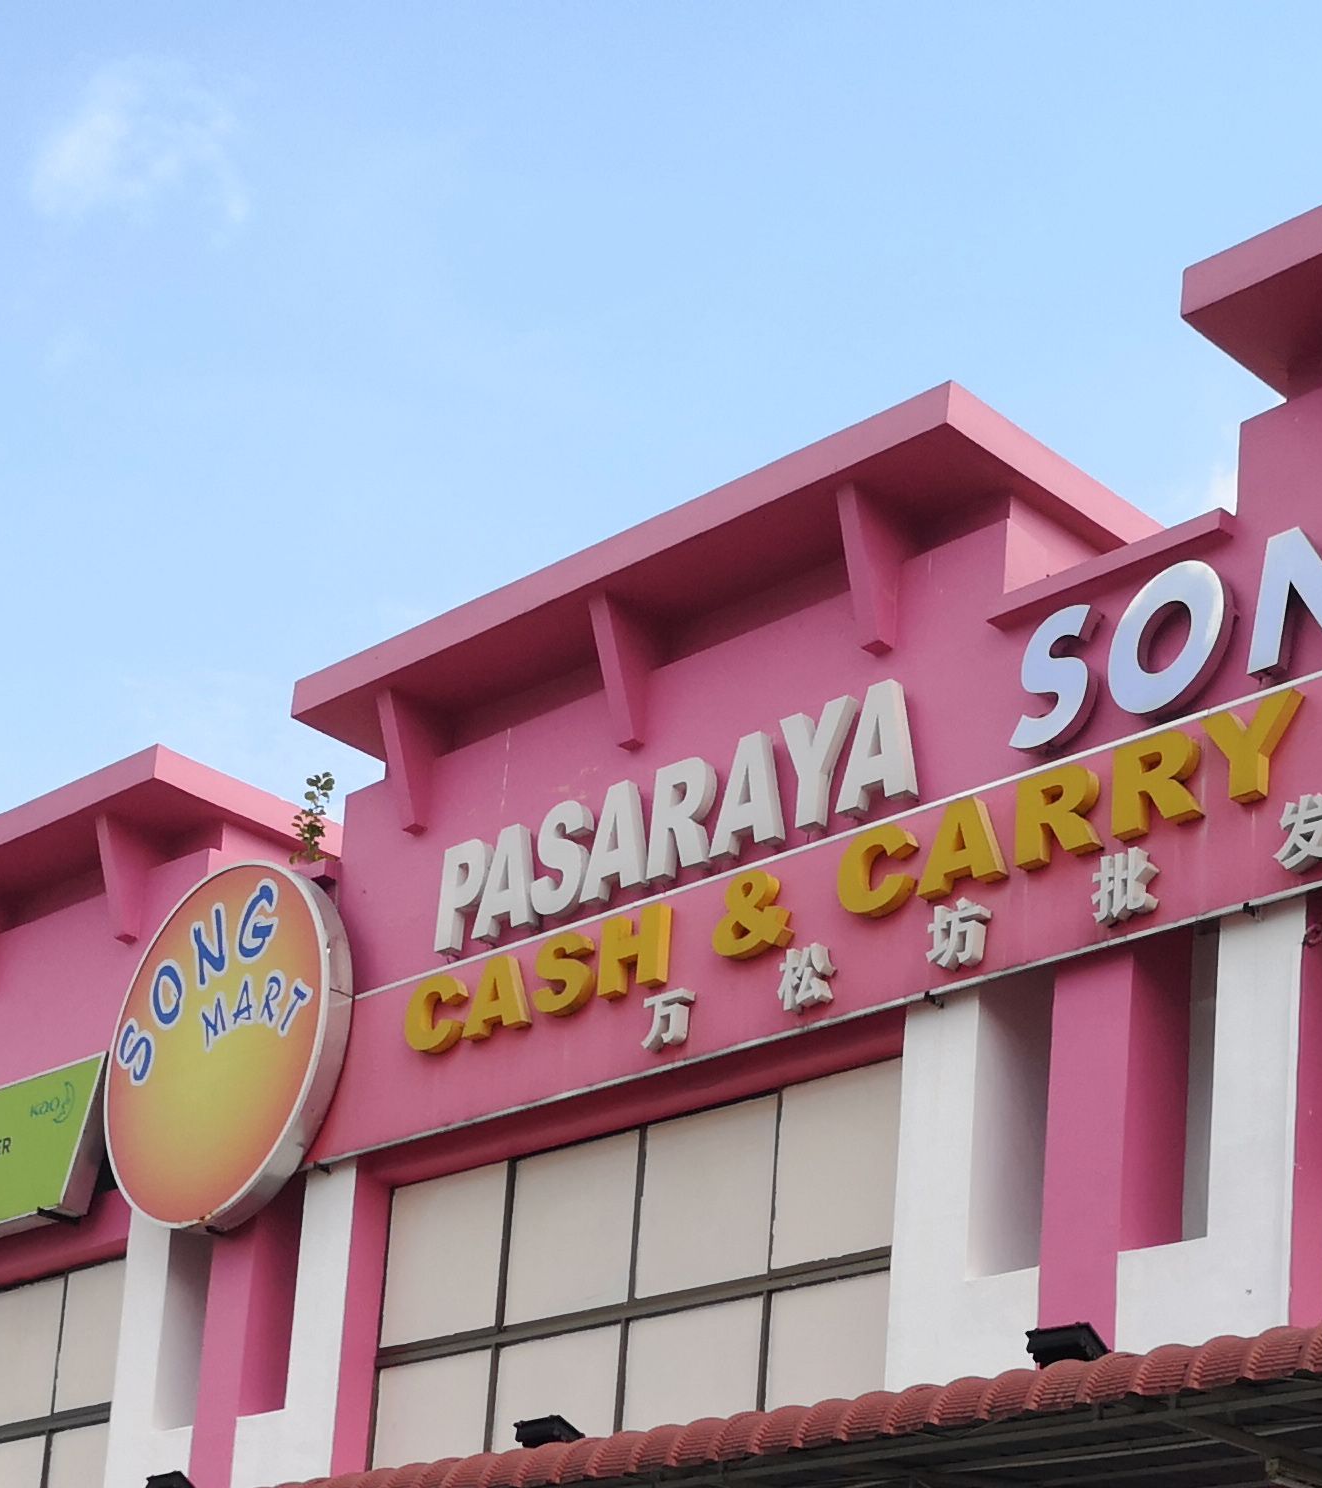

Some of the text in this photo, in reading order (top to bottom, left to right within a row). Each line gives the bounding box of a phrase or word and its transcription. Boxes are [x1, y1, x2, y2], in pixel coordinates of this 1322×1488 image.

[403, 902, 672, 1055] CASH
[711, 869, 796, 960] &
[836, 688, 1306, 918] CARRY
[433, 678, 919, 956] PASARAYA
[117, 881, 276, 1084] SONG
[199, 972, 311, 1049] MART
